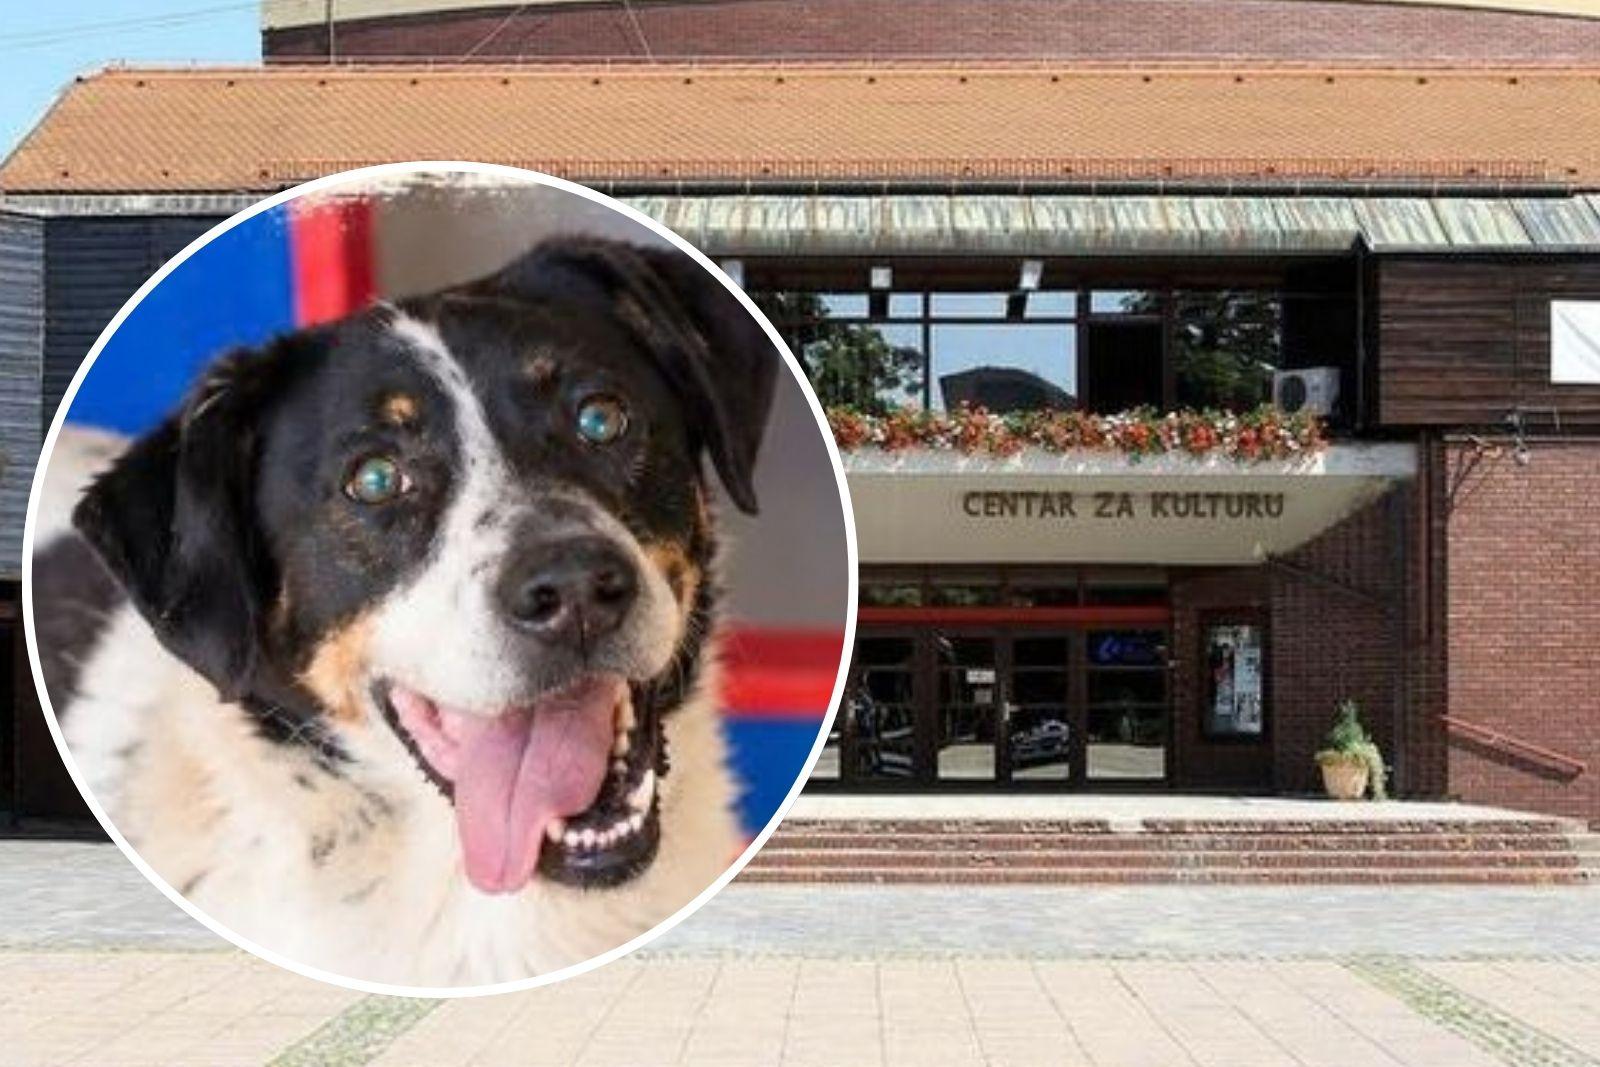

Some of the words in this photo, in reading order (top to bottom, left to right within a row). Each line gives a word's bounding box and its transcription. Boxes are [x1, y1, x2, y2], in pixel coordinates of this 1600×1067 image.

[962, 491, 1077, 518] CENTAR
[1094, 492, 1135, 518] ZA
[1150, 492, 1284, 518] KULTURU
